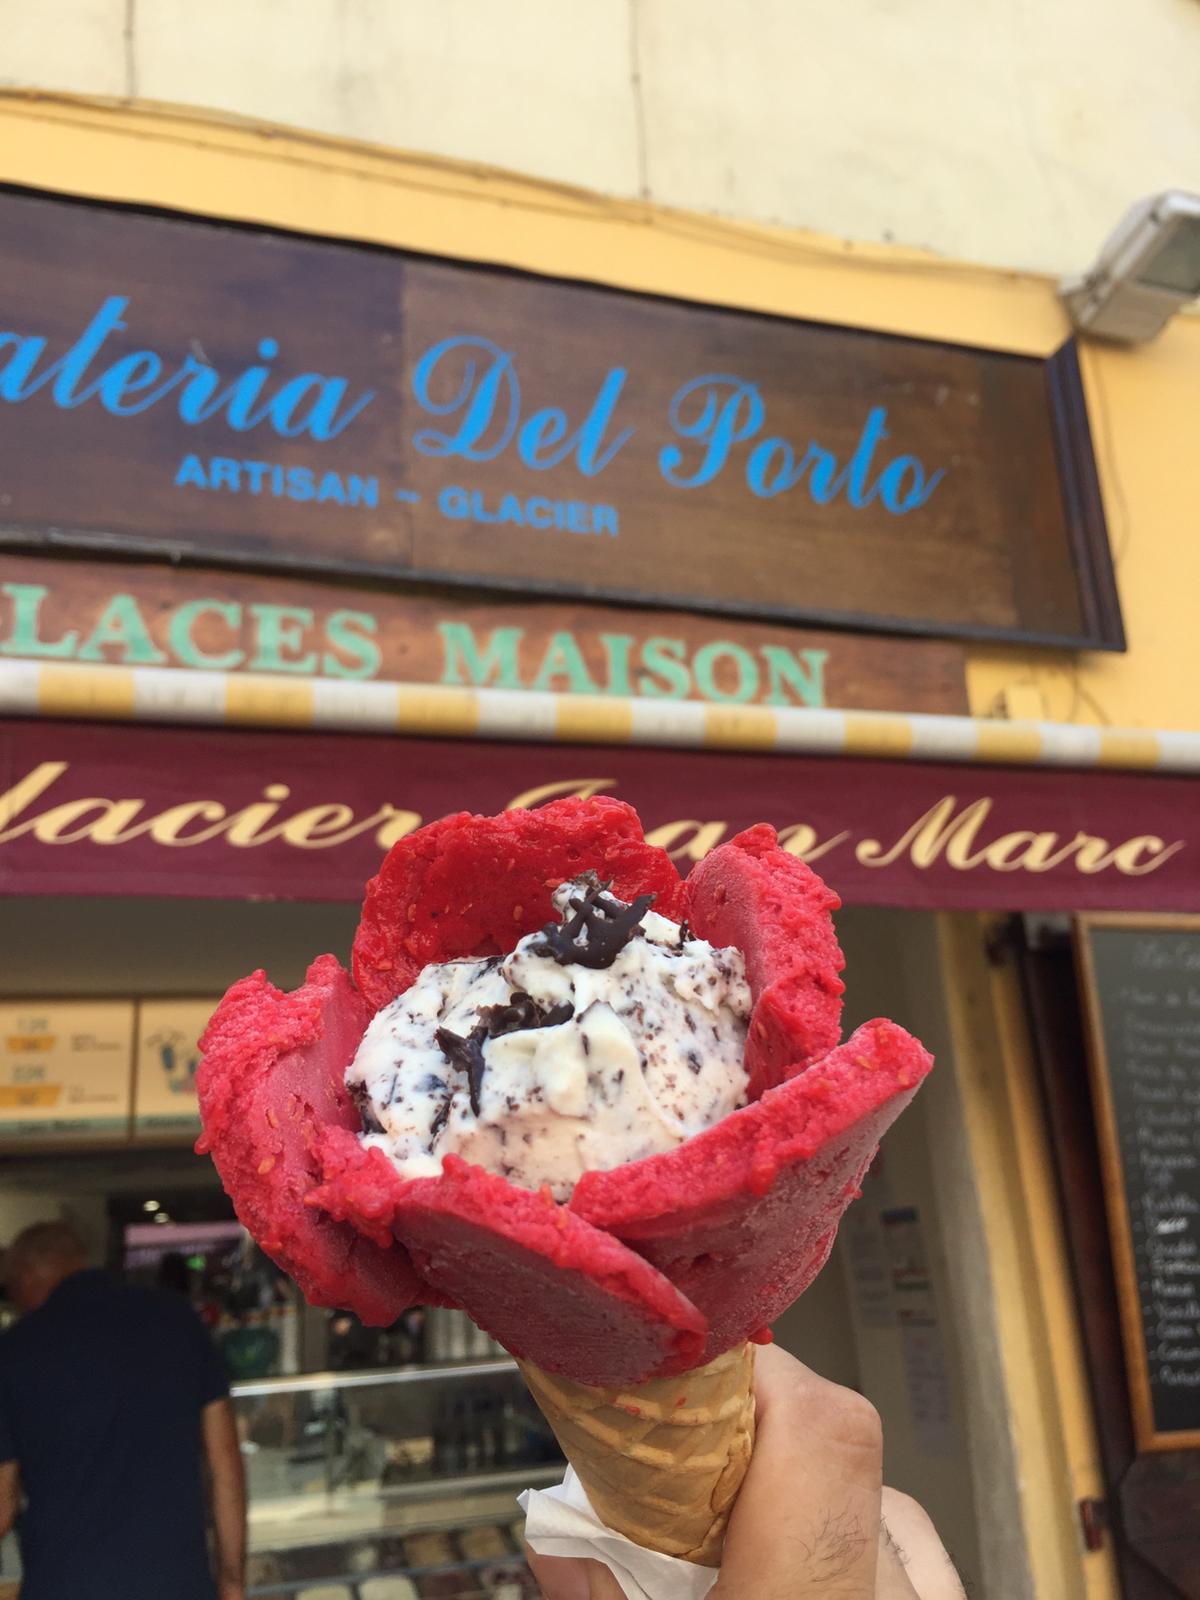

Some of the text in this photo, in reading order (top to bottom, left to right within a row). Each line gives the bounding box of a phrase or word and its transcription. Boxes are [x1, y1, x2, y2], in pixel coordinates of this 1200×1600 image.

[411, 335, 635, 477] Del
[658, 373, 945, 515] Porto
[174, 453, 379, 508] ARTISAN
[437, 486, 619, 537] GLACIER
[1, 583, 829, 708] LACES MAISON
[854, 795, 1186, 876] Marc
